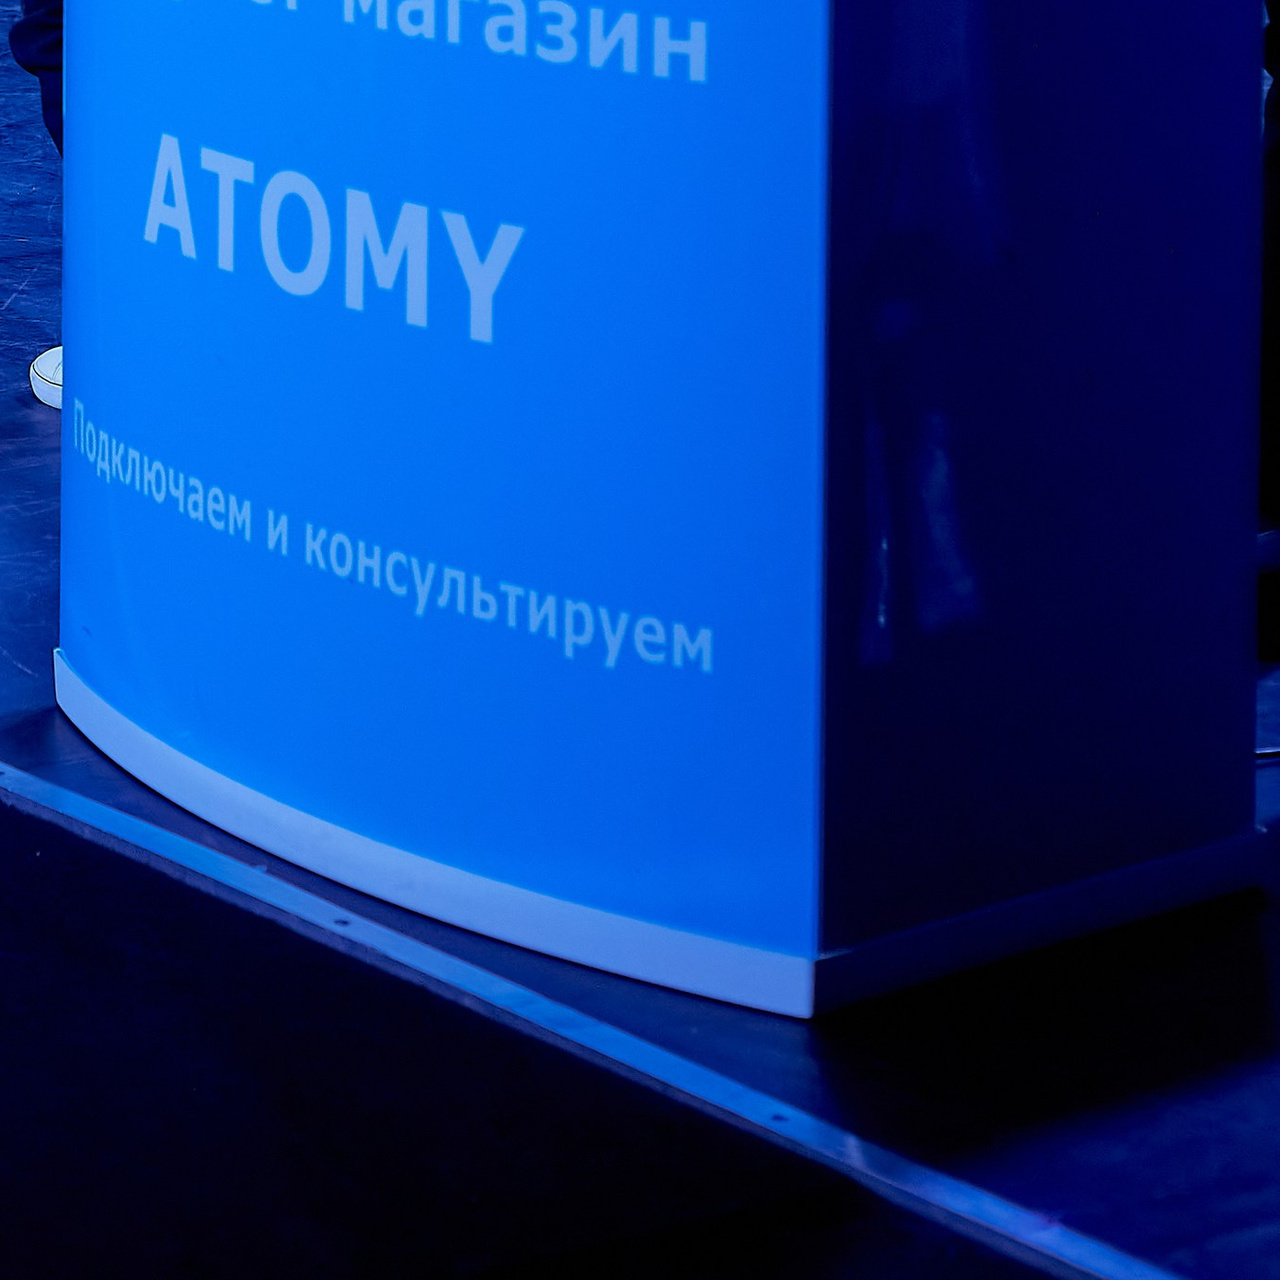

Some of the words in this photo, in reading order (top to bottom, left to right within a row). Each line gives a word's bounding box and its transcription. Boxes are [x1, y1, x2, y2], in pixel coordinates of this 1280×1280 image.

[143, 133, 524, 344] ATOMY
[73, 397, 252, 543] Подключаем
[266, 507, 289, 557] и
[303, 522, 714, 674] консультируем
